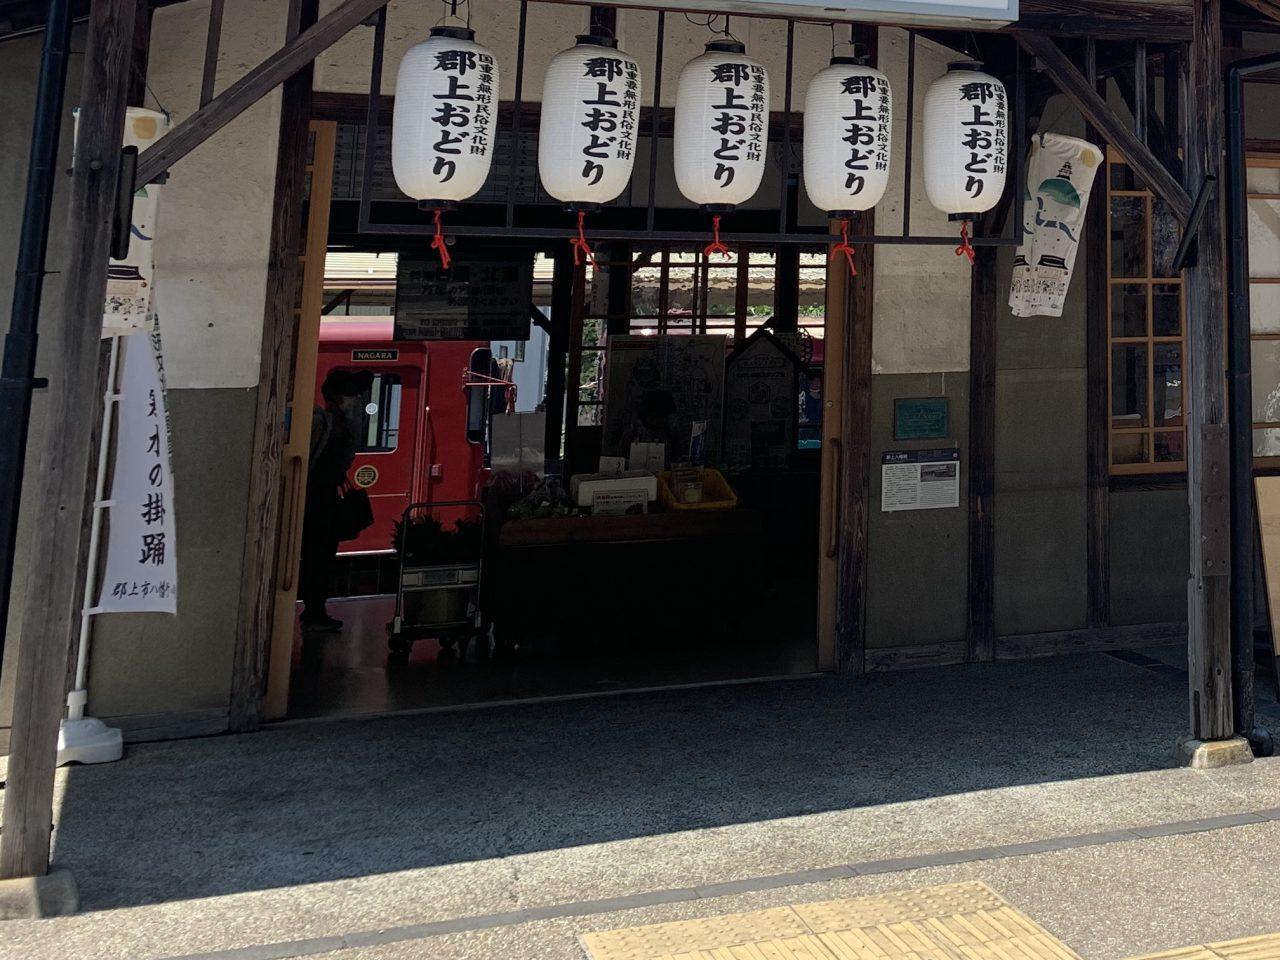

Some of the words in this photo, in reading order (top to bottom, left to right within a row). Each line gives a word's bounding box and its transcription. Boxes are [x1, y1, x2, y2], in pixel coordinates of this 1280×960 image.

[431, 50, 477, 183] 郡上おどり
[469, 53, 494, 157] 国重要無形民俗文化財
[581, 57, 624, 187] 郡上おどり
[616, 60, 638, 161] 国重要無形民俗文化財
[710, 62, 757, 189] 郡上おどり
[746, 64, 765, 162] 国重要無形民俗文化財
[840, 74, 877, 197] 郡上おどり
[875, 77, 892, 172] 国重要無形民俗文化財
[959, 82, 994, 199] 郡上おどり
[357, 352, 393, 360] NAGARA
[112, 581, 177, 601] 郡上市八幡
